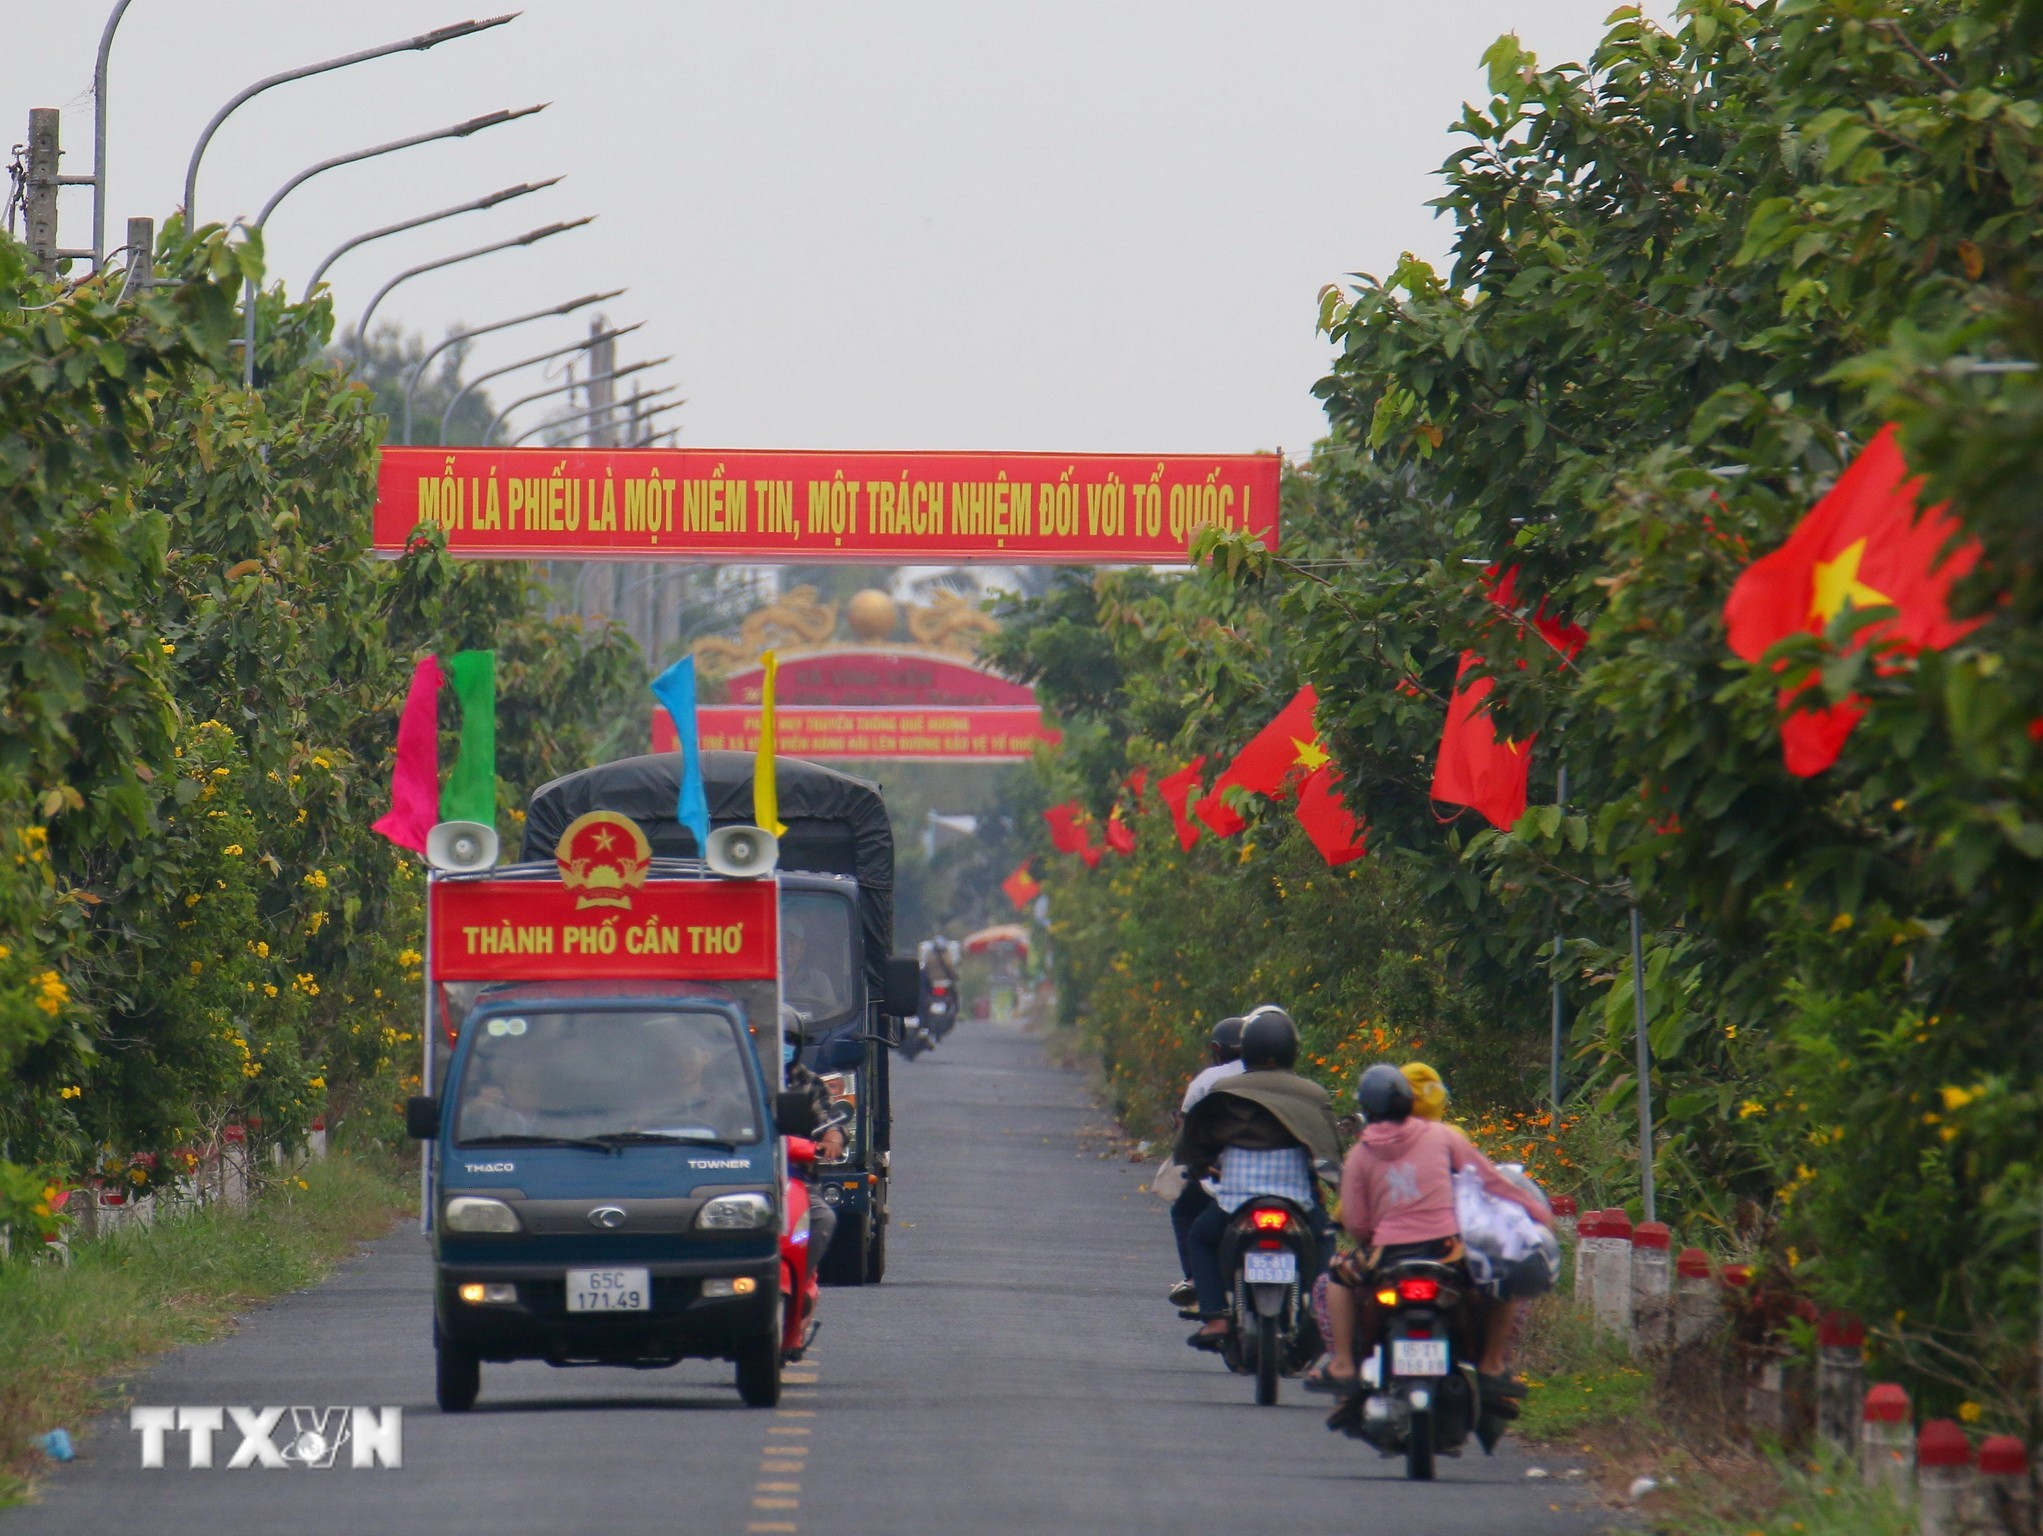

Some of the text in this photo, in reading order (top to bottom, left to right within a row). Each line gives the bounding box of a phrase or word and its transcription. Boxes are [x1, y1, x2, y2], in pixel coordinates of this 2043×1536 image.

[419, 456, 465, 530] MỖI
[472, 466, 500, 530] LÁ
[508, 460, 580, 532] PHIẾU
[588, 468, 617, 532] LÀ
[624, 467, 676, 544] MỘT
[683, 462, 747, 533] NIỀM
[755, 480, 800, 541] TIN,
[808, 469, 860, 546] MỘT
[867, 467, 943, 535] TRÁCH
[951, 470, 1032, 547] NHIỆM
[1039, 465, 1079, 536] ĐỐI
[1087, 472, 1126, 536] VỚI
[1133, 462, 1165, 537] TỔ
[1169, 467, 1234, 543] QUỐC
[463, 914, 743, 954] THÀNH PHỐ CẦN THƠ
[465, 1162, 515, 1173] THACO
[688, 1159, 750, 1170] TOWNER
[589, 1270, 625, 1288] 65C
[577, 1289, 640, 1309] 171.49
